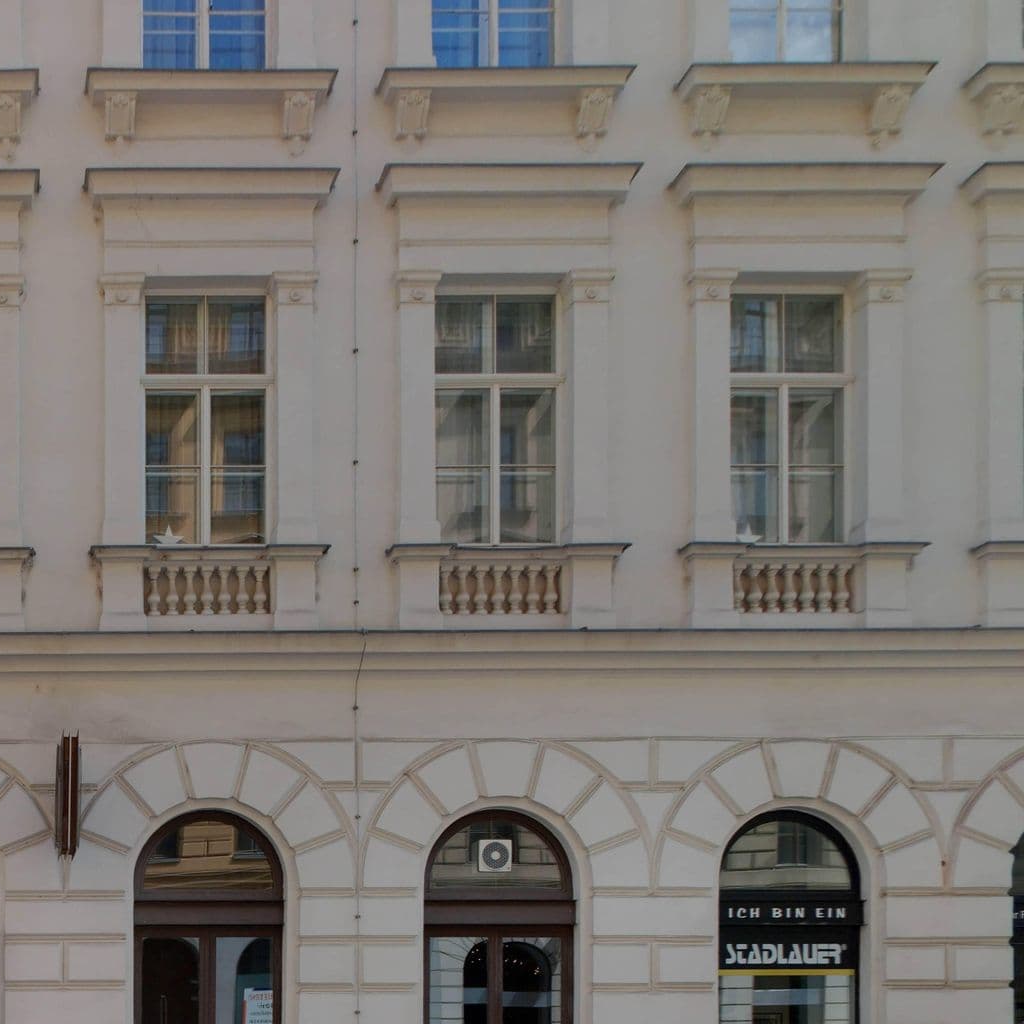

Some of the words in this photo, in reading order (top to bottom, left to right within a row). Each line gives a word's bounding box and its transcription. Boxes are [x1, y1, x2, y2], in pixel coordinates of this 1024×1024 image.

[728, 907, 760, 919] ICH
[771, 907, 805, 919] BIN
[815, 907, 847, 919] EIN
